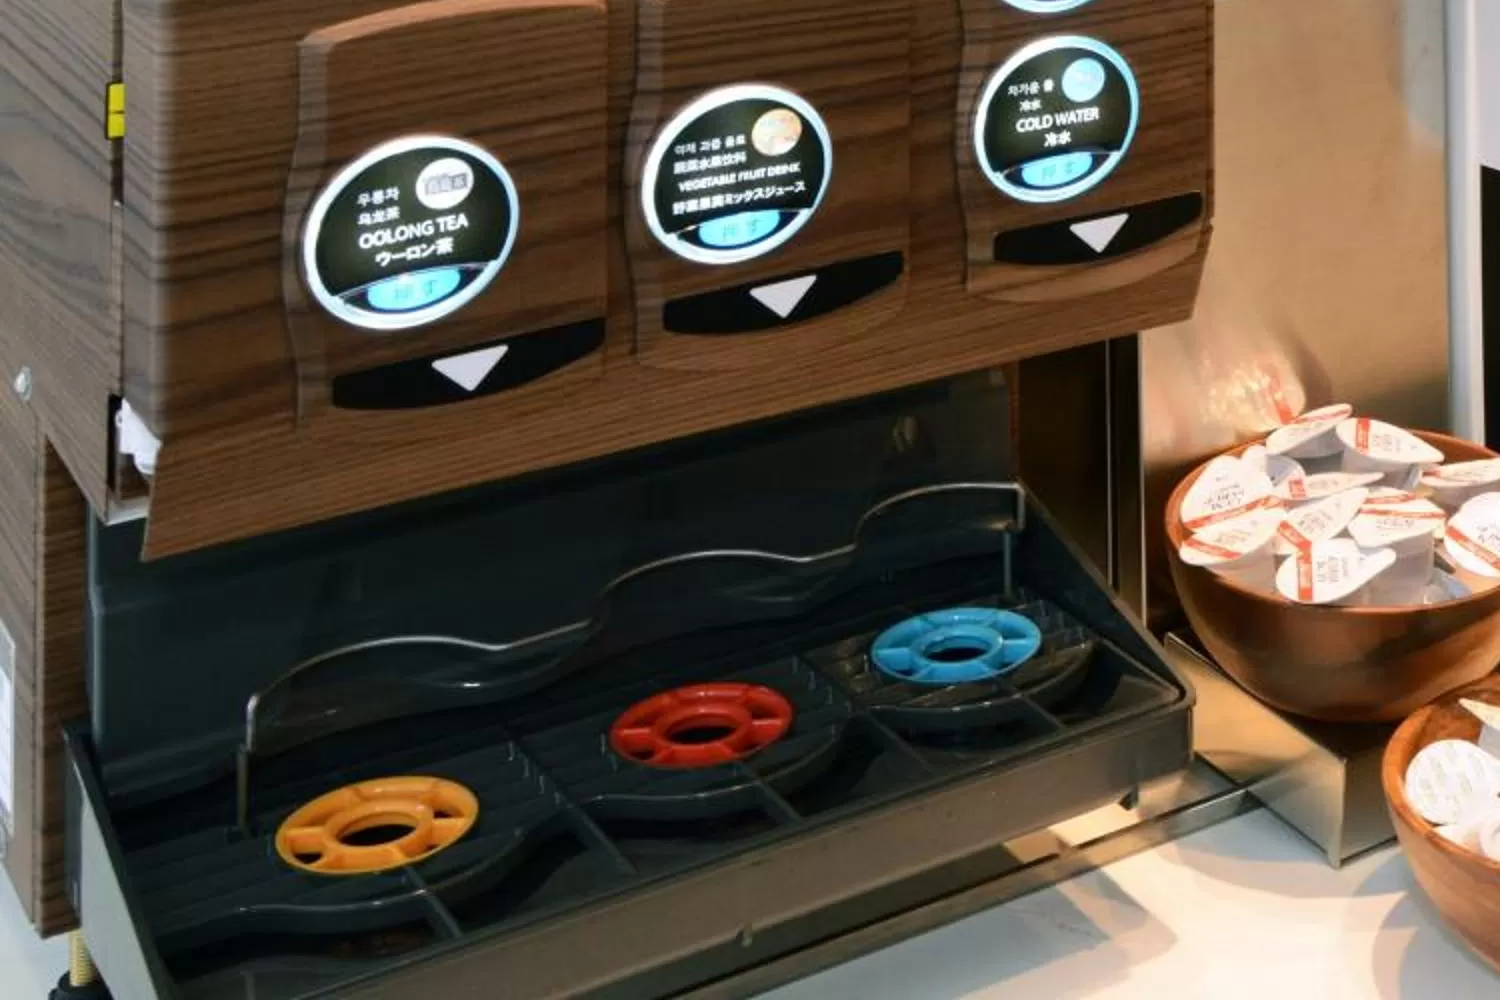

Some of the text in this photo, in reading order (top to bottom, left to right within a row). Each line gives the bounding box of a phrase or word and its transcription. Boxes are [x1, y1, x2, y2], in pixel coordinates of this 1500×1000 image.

[1015, 107, 1100, 133] COLD WATER
[678, 161, 801, 193] VEGETABLE FRUIT DRINK
[358, 213, 468, 250] OOLONG TEA
[374, 237, 454, 267] ウーロン茶
